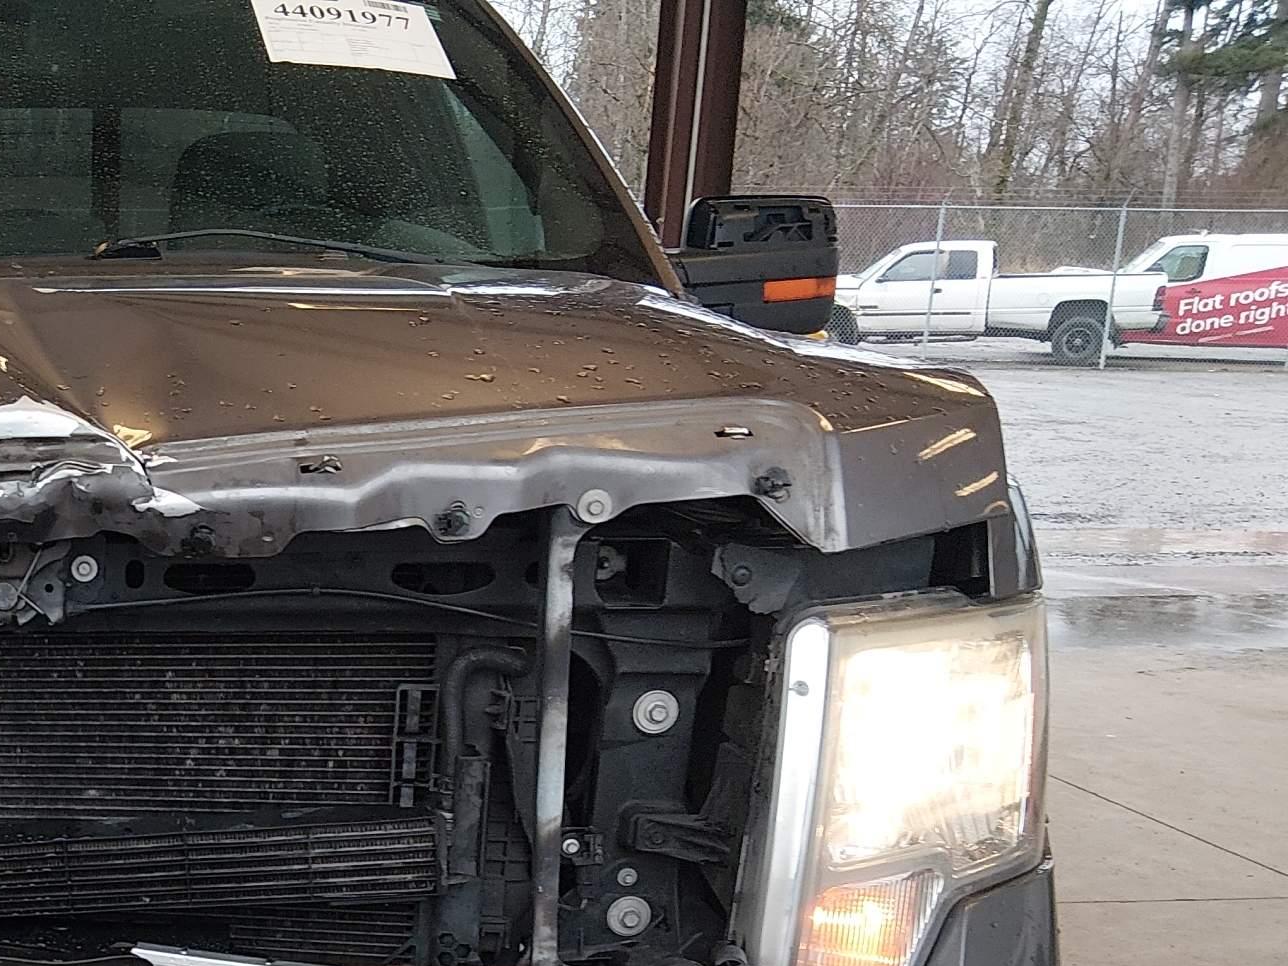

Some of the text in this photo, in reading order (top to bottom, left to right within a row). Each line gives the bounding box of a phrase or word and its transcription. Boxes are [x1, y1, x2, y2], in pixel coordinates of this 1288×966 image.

[274, 3, 410, 30] 44091977
[1178, 281, 1288, 316] Flat roofs
[1176, 314, 1234, 335] done
